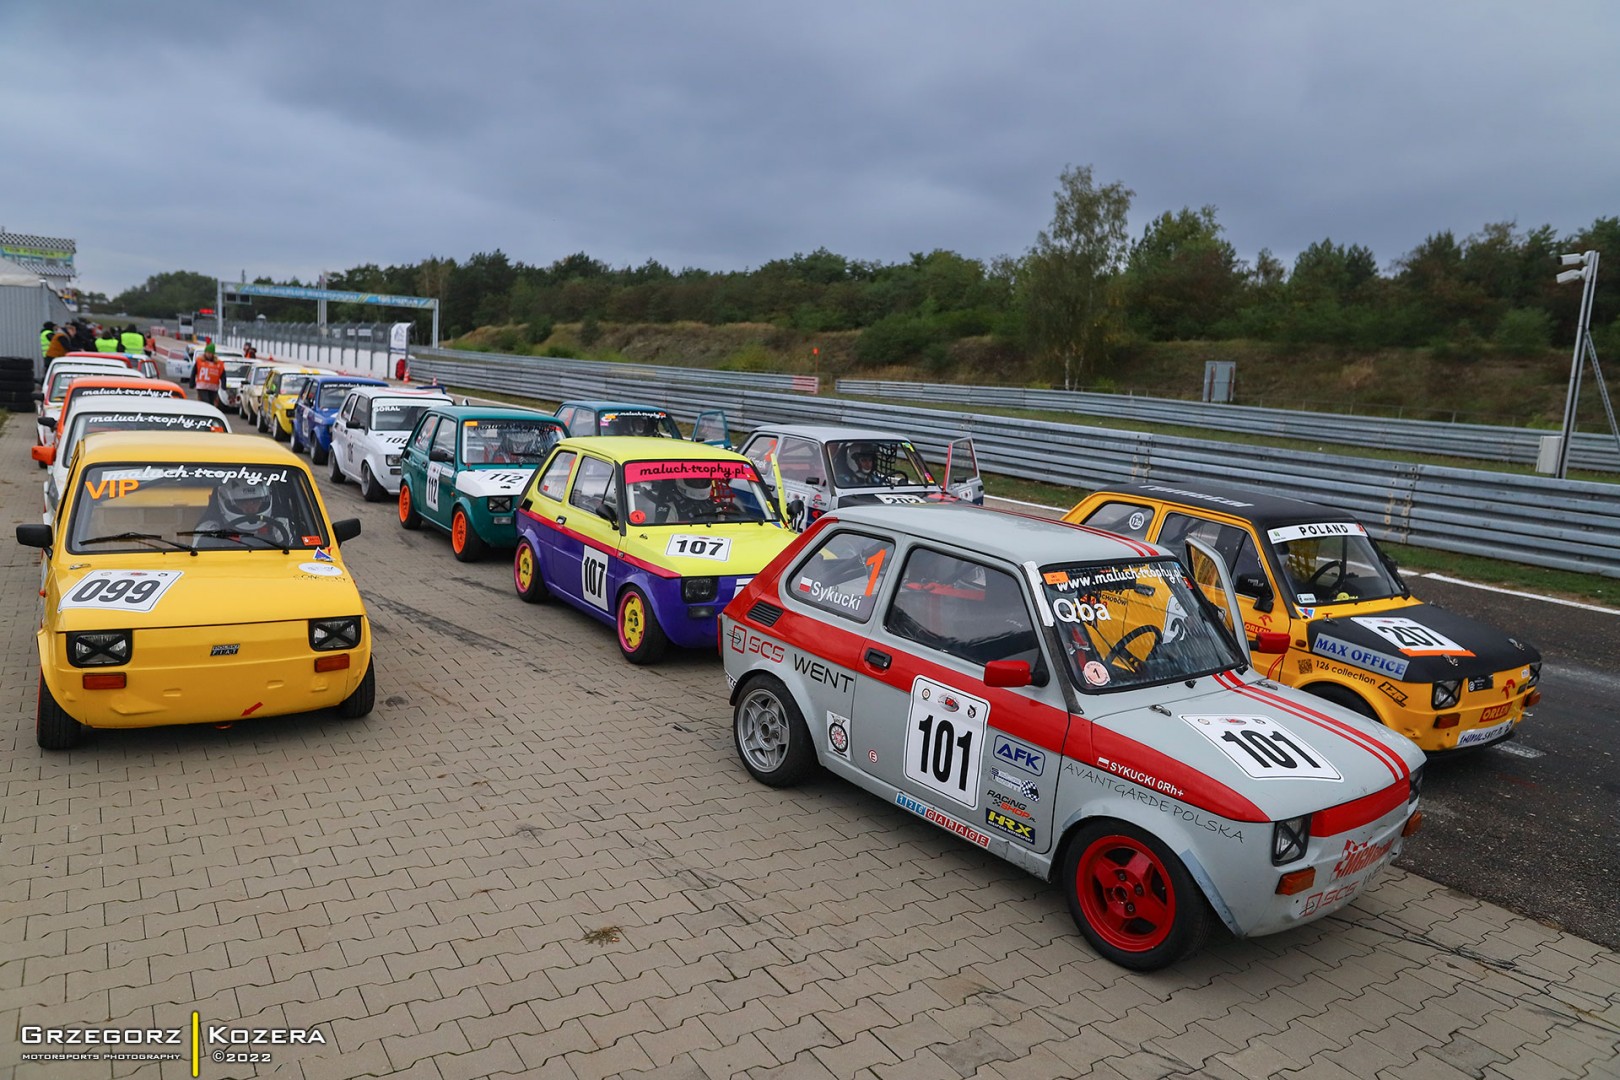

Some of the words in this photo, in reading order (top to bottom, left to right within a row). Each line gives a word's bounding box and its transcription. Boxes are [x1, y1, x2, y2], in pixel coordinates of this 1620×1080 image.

[199, 367, 210, 380] PL
[82, 388, 173, 397] maluch-trophy.pl
[89, 413, 212, 429] maluch-trophy.pl
[107, 465, 288, 486] maluch-trophy.pl
[488, 472, 525, 484] 112
[640, 463, 746, 478] maluch-trophy.pl
[85, 479, 141, 500] VIP
[427, 476, 437, 504] 112
[1298, 524, 1348, 536] POLAND
[676, 540, 724, 556] 107
[584, 556, 606, 599] 107
[864, 549, 887, 597] 1
[72, 579, 160, 604] 099
[811, 581, 862, 611] Sykucki
[1053, 598, 1111, 624] Qba
[1377, 626, 1445, 647] 207
[749, 636, 785, 663] SCS
[1315, 638, 1347, 658] MAX
[1350, 649, 1405, 676] OFFICE
[793, 653, 855, 693] WENT
[1093, 667, 1100, 679] 1
[1315, 660, 1330, 671] 126
[1332, 666, 1376, 685] collection
[1482, 702, 1511, 720] ORLEN
[918, 714, 972, 792] 101
[996, 743, 1041, 771] AFK
[1220, 730, 1321, 769] 101
[1110, 762, 1156, 787] SYKUCKI
[1064, 762, 1169, 813] AVANTGARDE
[1173, 804, 1244, 844] POLSKA
[926, 808, 989, 847] GARAGE
[988, 810, 1032, 838] HRX
[1322, 881, 1360, 906] SCS
